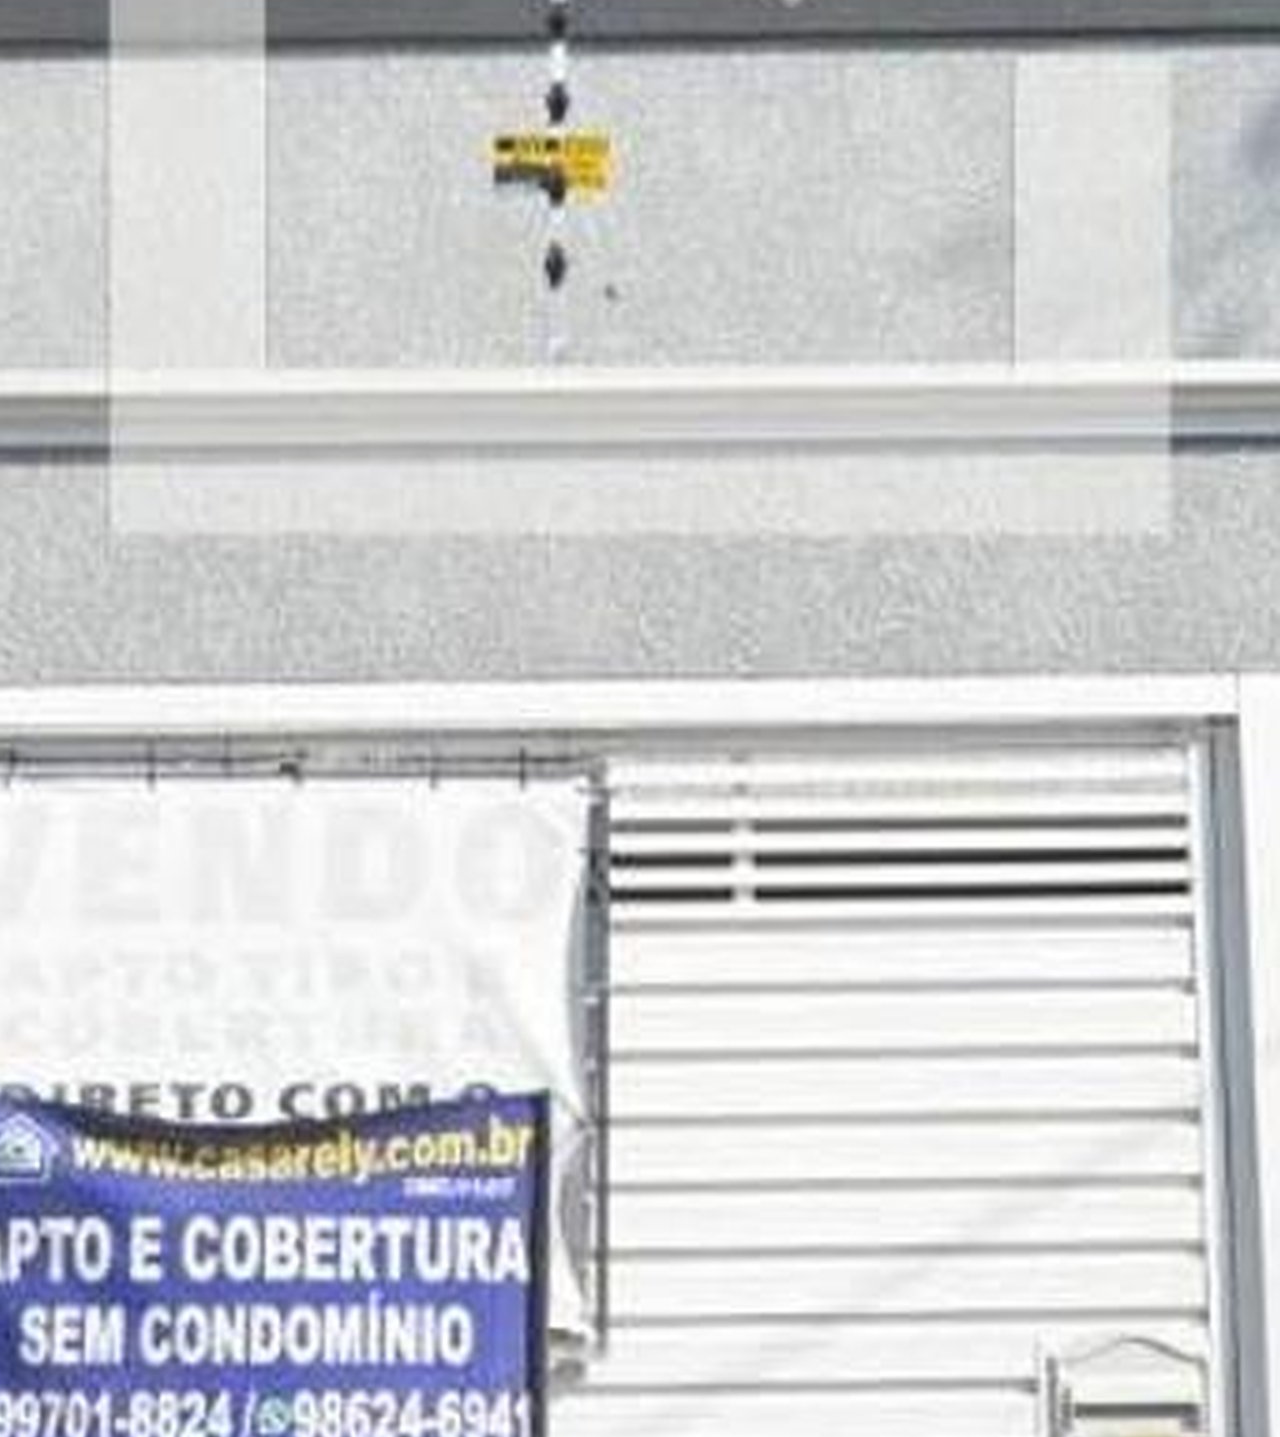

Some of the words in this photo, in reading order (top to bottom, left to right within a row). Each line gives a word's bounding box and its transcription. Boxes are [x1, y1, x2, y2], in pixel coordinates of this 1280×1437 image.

[128, 1217, 164, 1282] E
[180, 1215, 531, 1285] COBERTURA
[18, 1304, 124, 1366] SEM
[139, 1290, 474, 1368] CONDOMÍNIO
